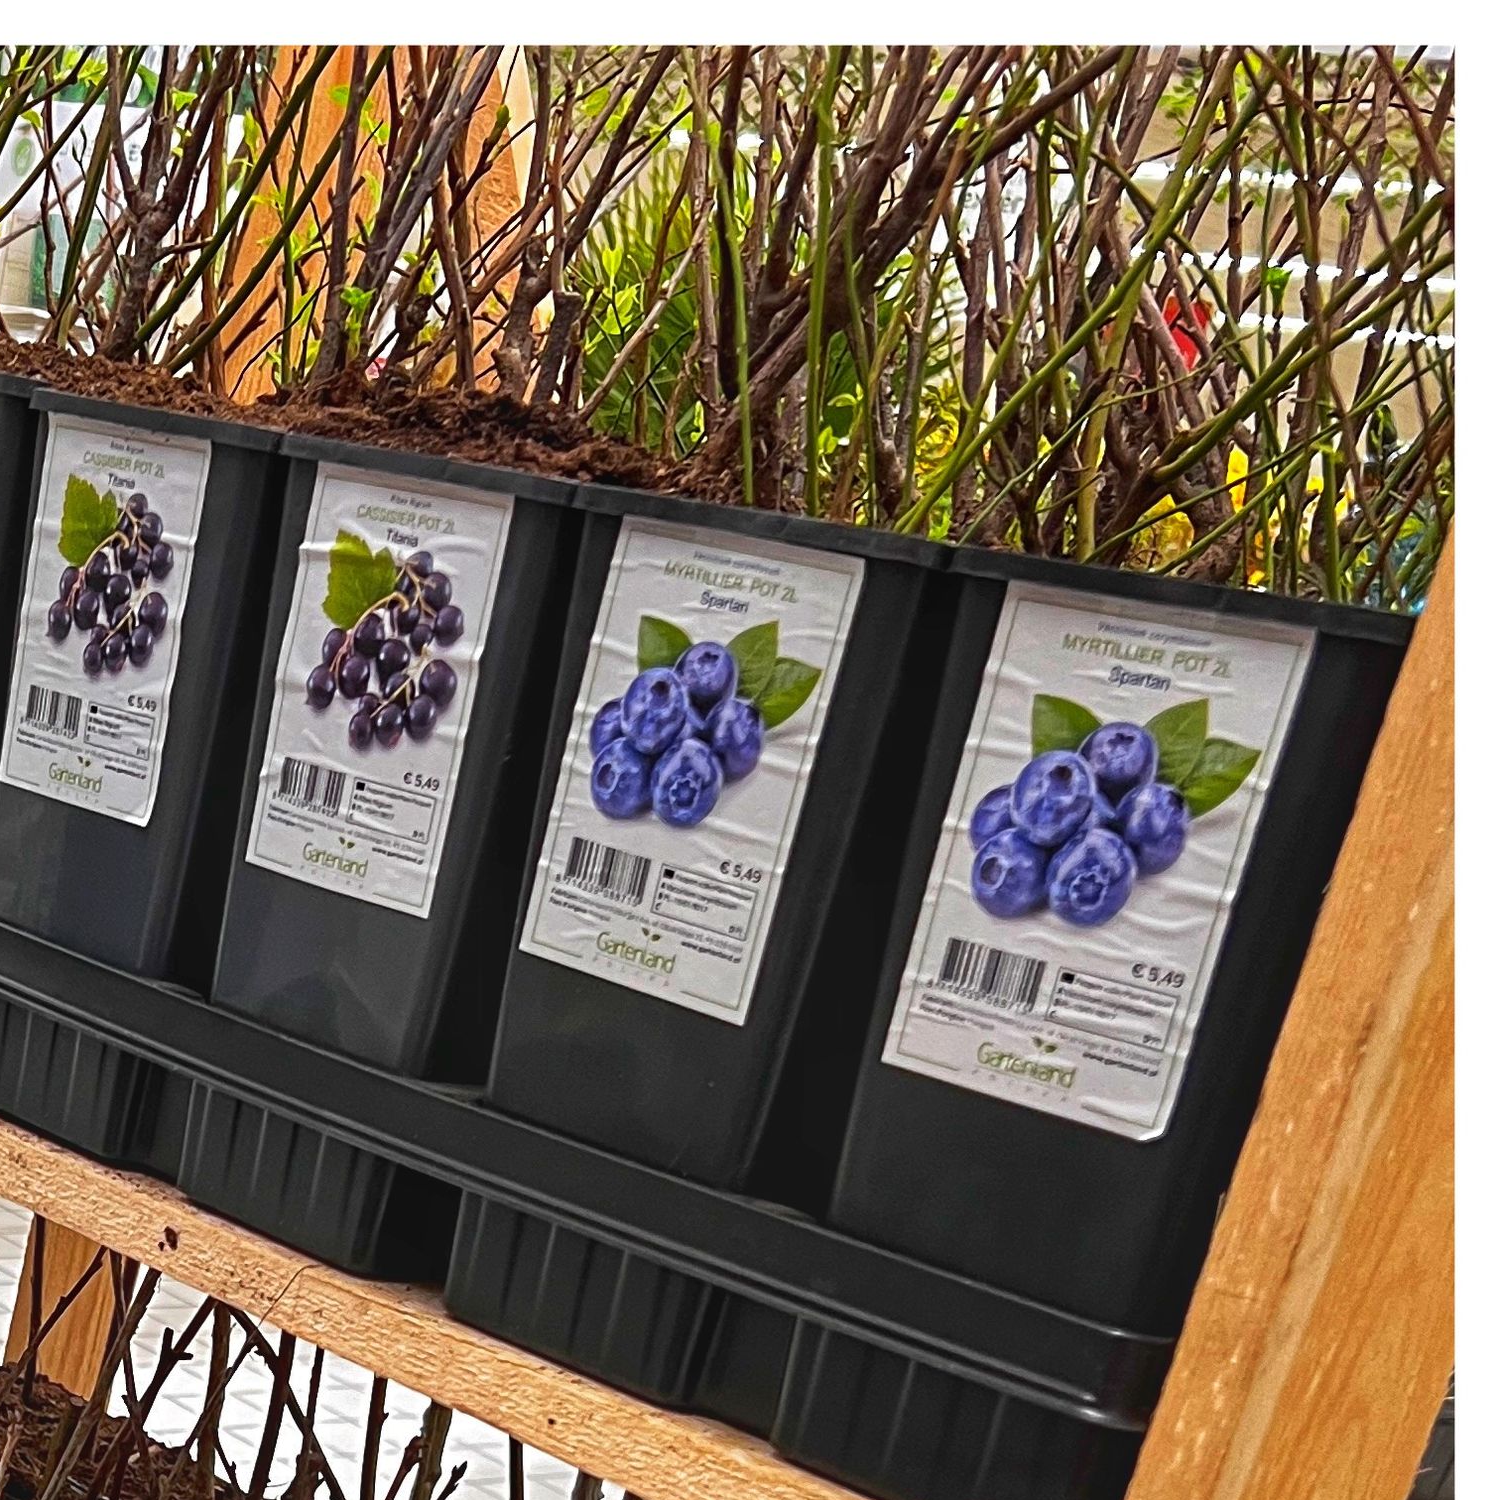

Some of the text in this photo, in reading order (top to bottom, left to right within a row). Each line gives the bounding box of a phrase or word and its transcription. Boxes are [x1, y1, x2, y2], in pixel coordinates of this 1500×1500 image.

[133, 459, 153, 475] POT
[418, 514, 443, 532] POT
[700, 590, 749, 613] Spartan
[749, 577, 780, 597] POT
[781, 586, 799, 603] 2L
[1172, 650, 1211, 673] POT
[1108, 665, 1172, 692] Spartan
[403, 772, 440, 791] € 5,49
[302, 842, 368, 878] Gartenland
[719, 859, 763, 884] € 5,49
[596, 931, 676, 974] Gartenland
[1131, 963, 1186, 989] € 5,49
[977, 1041, 1077, 1088] Gartenland
